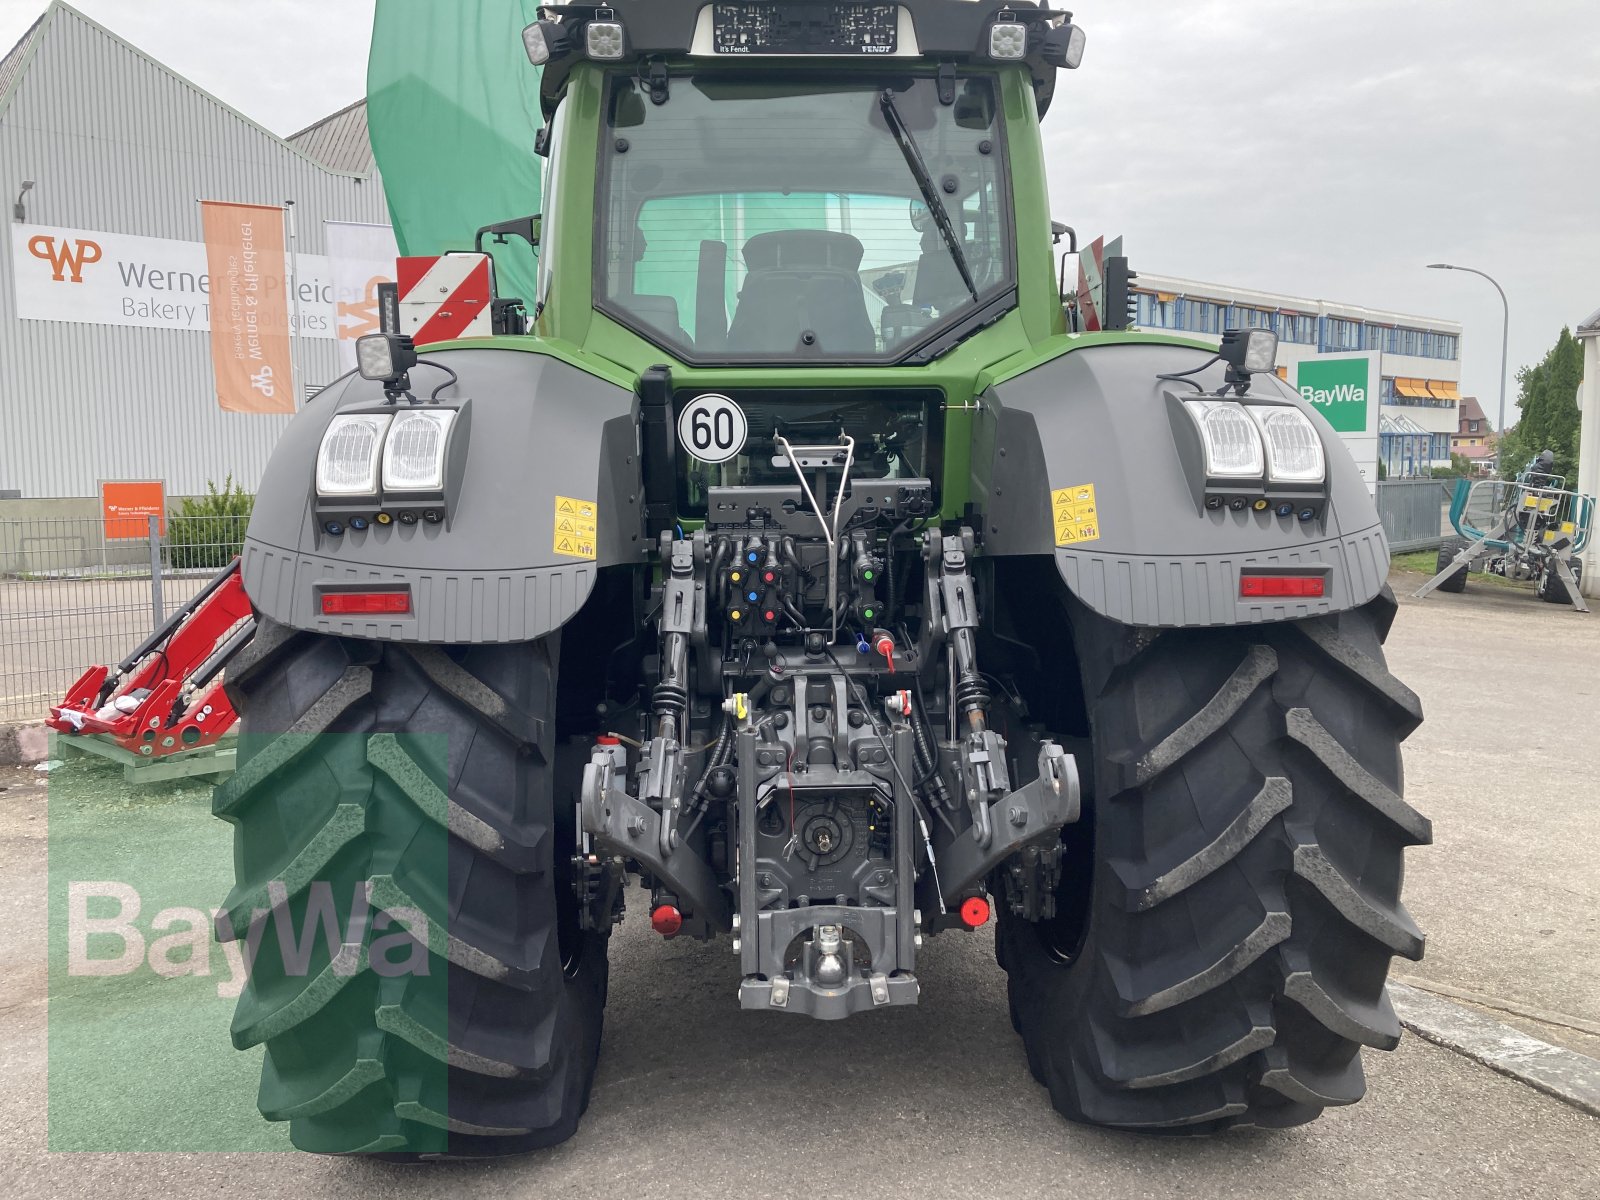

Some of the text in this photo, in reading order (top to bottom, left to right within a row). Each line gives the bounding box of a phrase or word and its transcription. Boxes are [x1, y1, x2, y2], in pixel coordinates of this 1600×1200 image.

[861, 45, 892, 53] FENDT
[122, 296, 196, 326] Bakery
[1300, 383, 1366, 407] BayWa
[692, 407, 734, 450] 60
